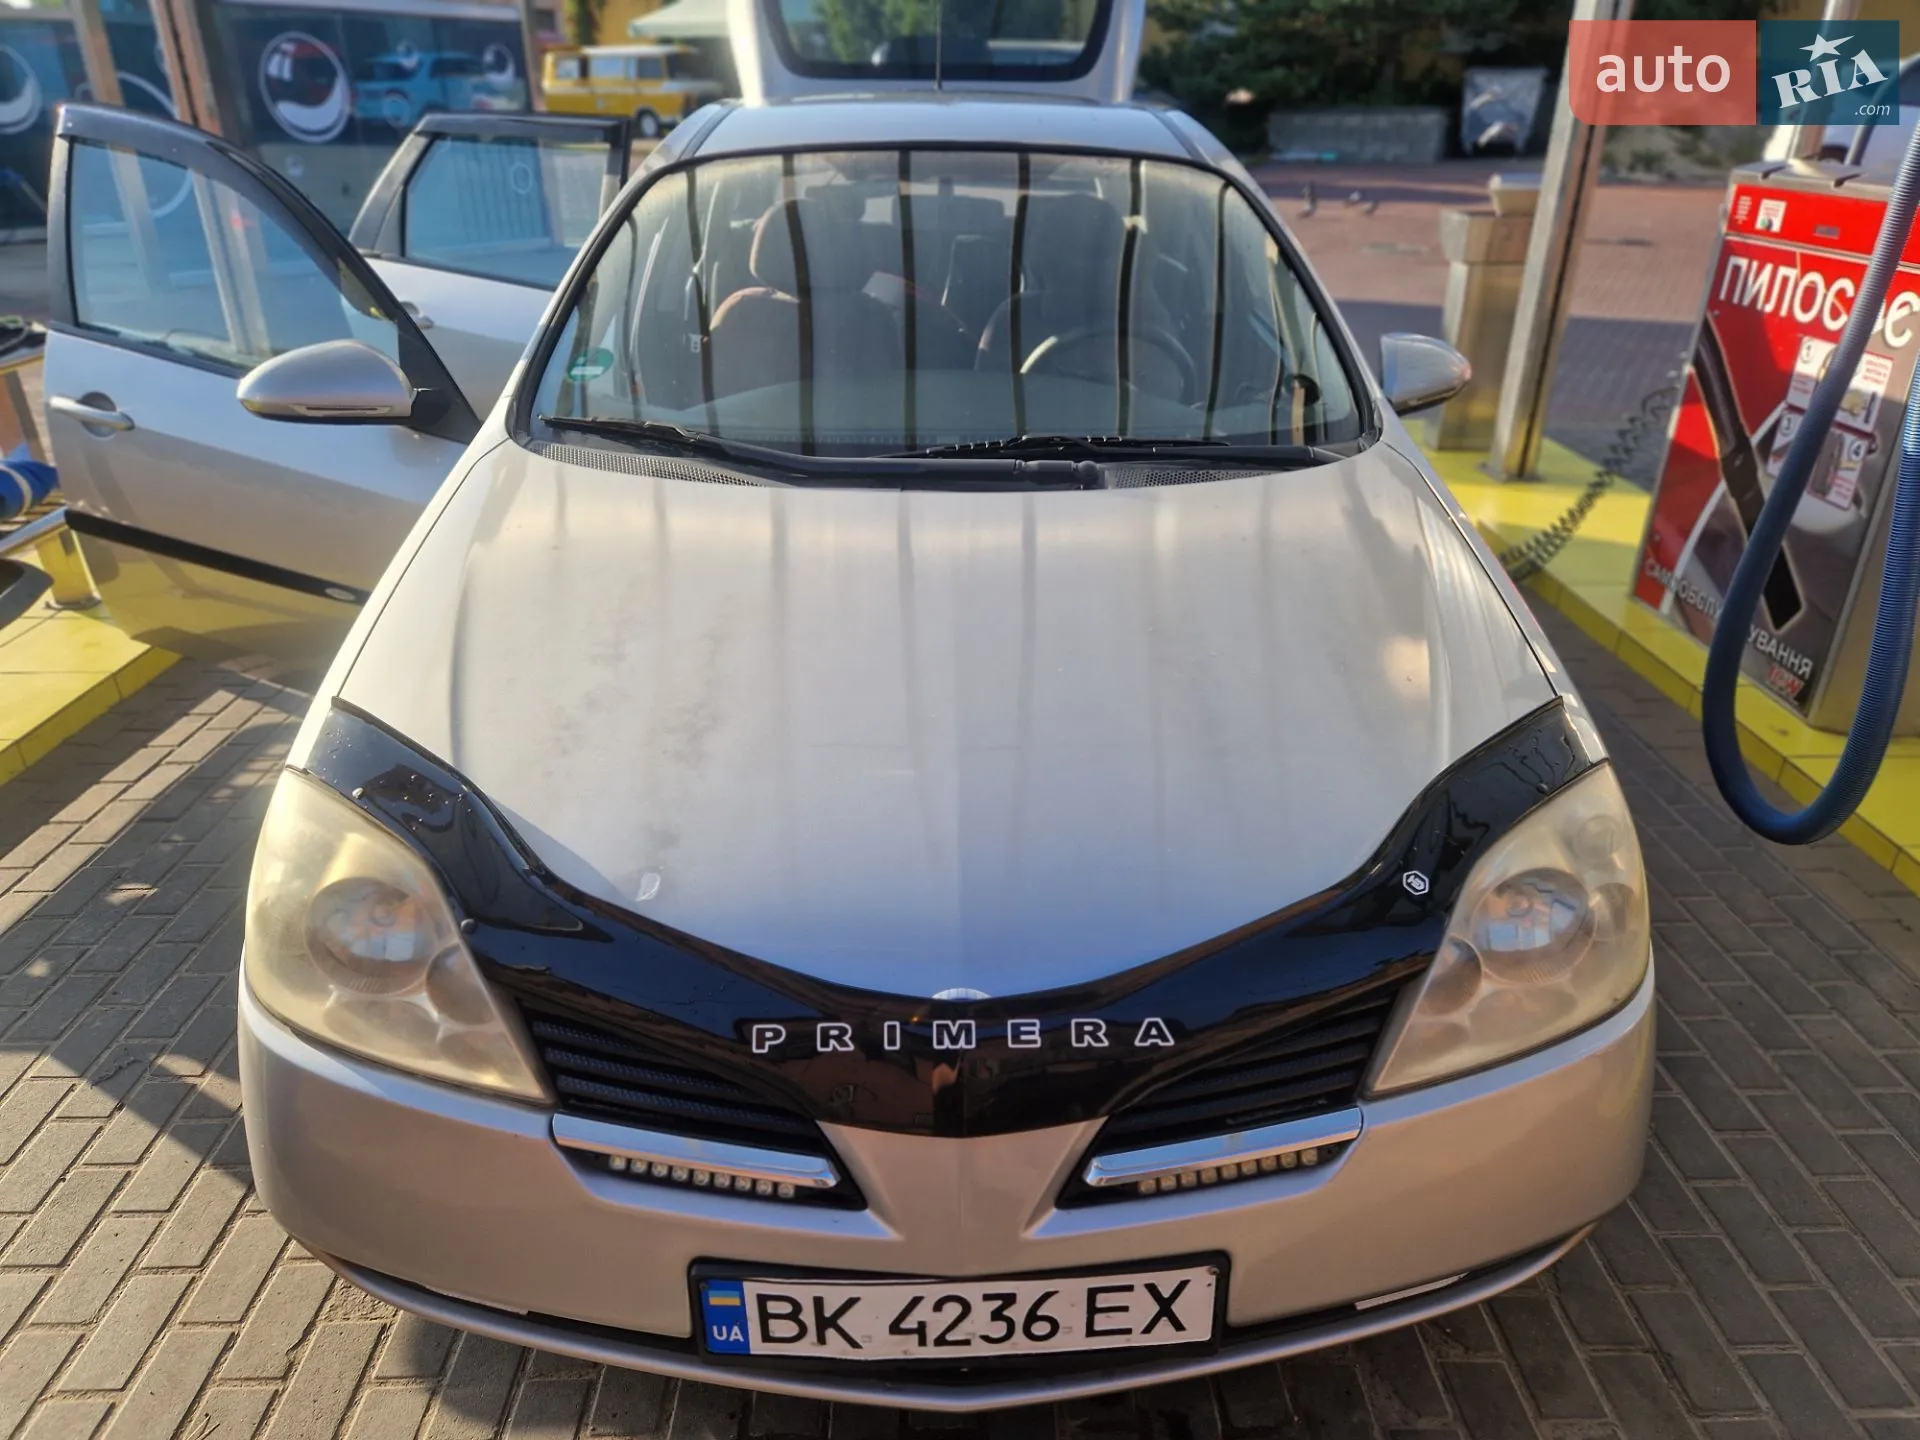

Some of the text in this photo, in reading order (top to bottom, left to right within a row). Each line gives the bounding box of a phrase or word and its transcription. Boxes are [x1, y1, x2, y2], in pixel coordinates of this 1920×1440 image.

[752, 1017, 1175, 1054] PRIMERA
[713, 1323, 744, 1343] UA
[755, 1279, 1192, 1350] BK 4236 EX
